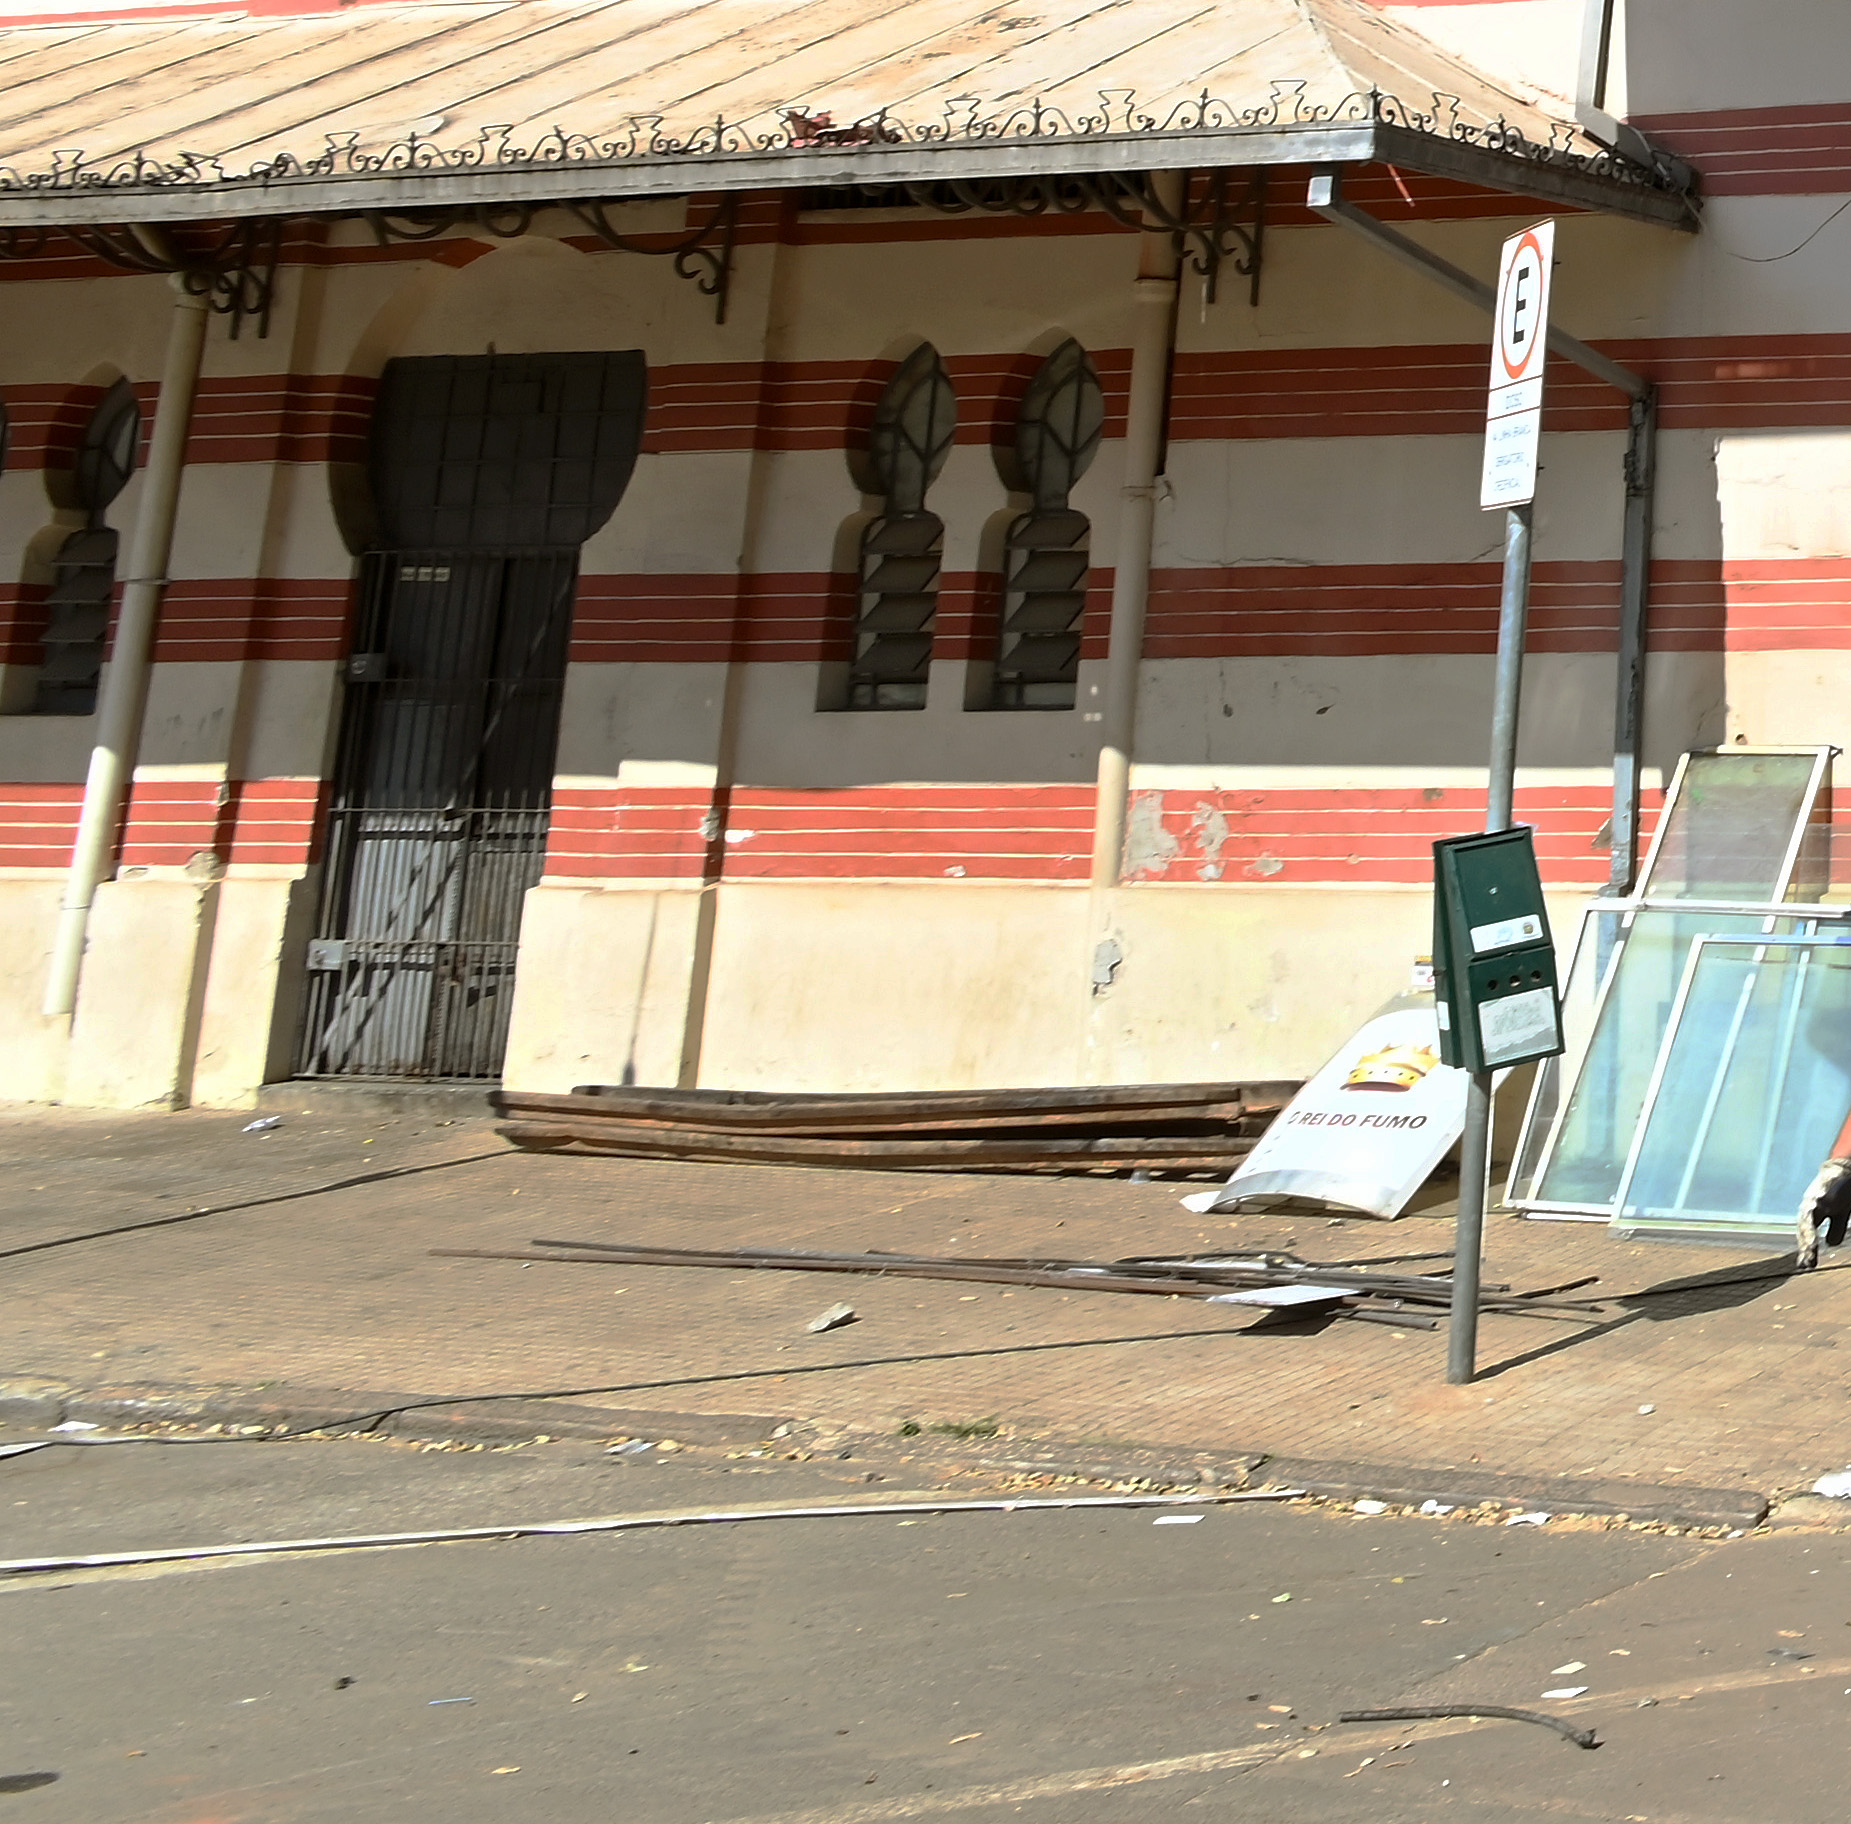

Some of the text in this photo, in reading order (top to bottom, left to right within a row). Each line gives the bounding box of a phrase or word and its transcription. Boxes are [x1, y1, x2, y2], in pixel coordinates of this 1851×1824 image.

[1513, 266, 1530, 344] E
[1299, 1112, 1329, 1126] REI
[1327, 1113, 1357, 1126] DO
[1359, 1114, 1428, 1129] FUMO
